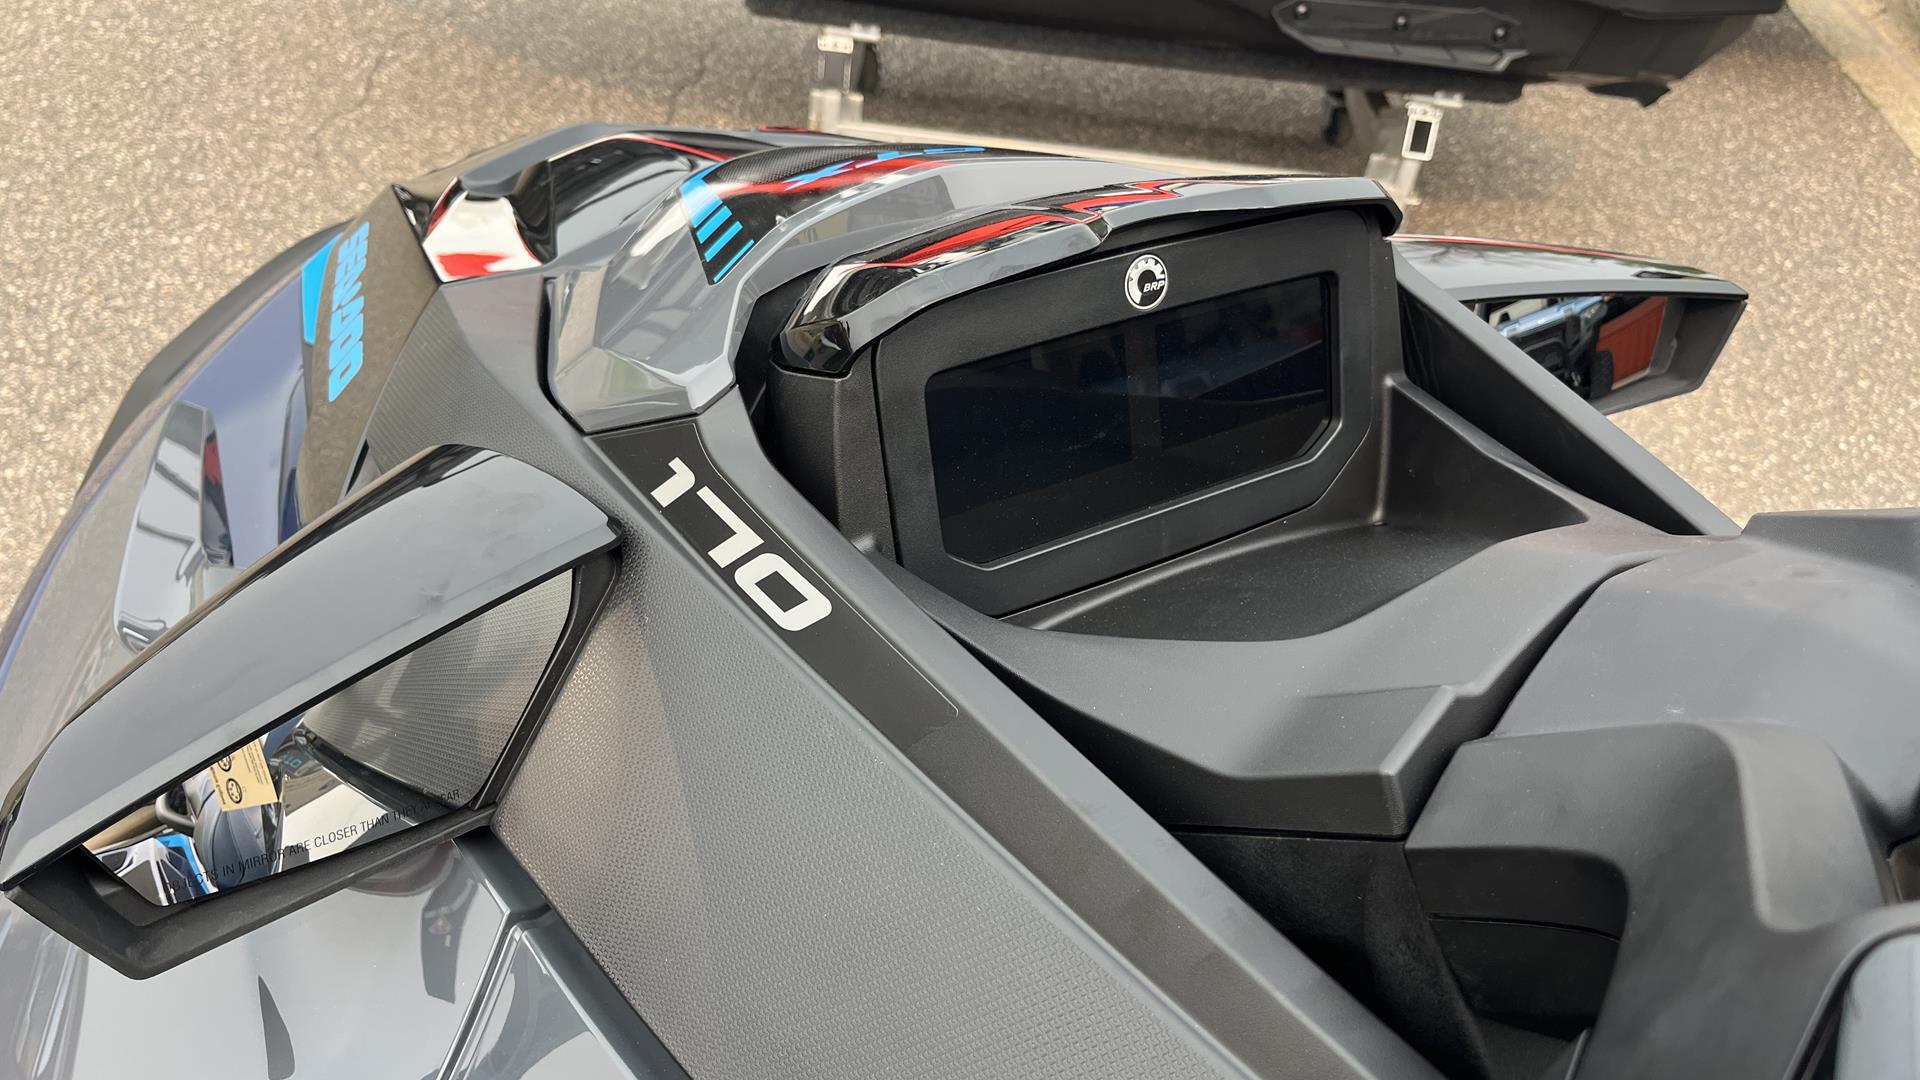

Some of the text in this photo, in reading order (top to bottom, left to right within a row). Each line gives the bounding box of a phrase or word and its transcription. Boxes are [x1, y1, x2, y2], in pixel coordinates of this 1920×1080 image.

[1143, 280, 1165, 293] BRP
[650, 456, 833, 632] 170
[222, 863, 235, 877] IN
[240, 848, 286, 870] MIRROR
[289, 839, 311, 856] ARE
[314, 824, 358, 848] CLOSER
[360, 812, 389, 832] THAN
[392, 804, 417, 821] THEY
